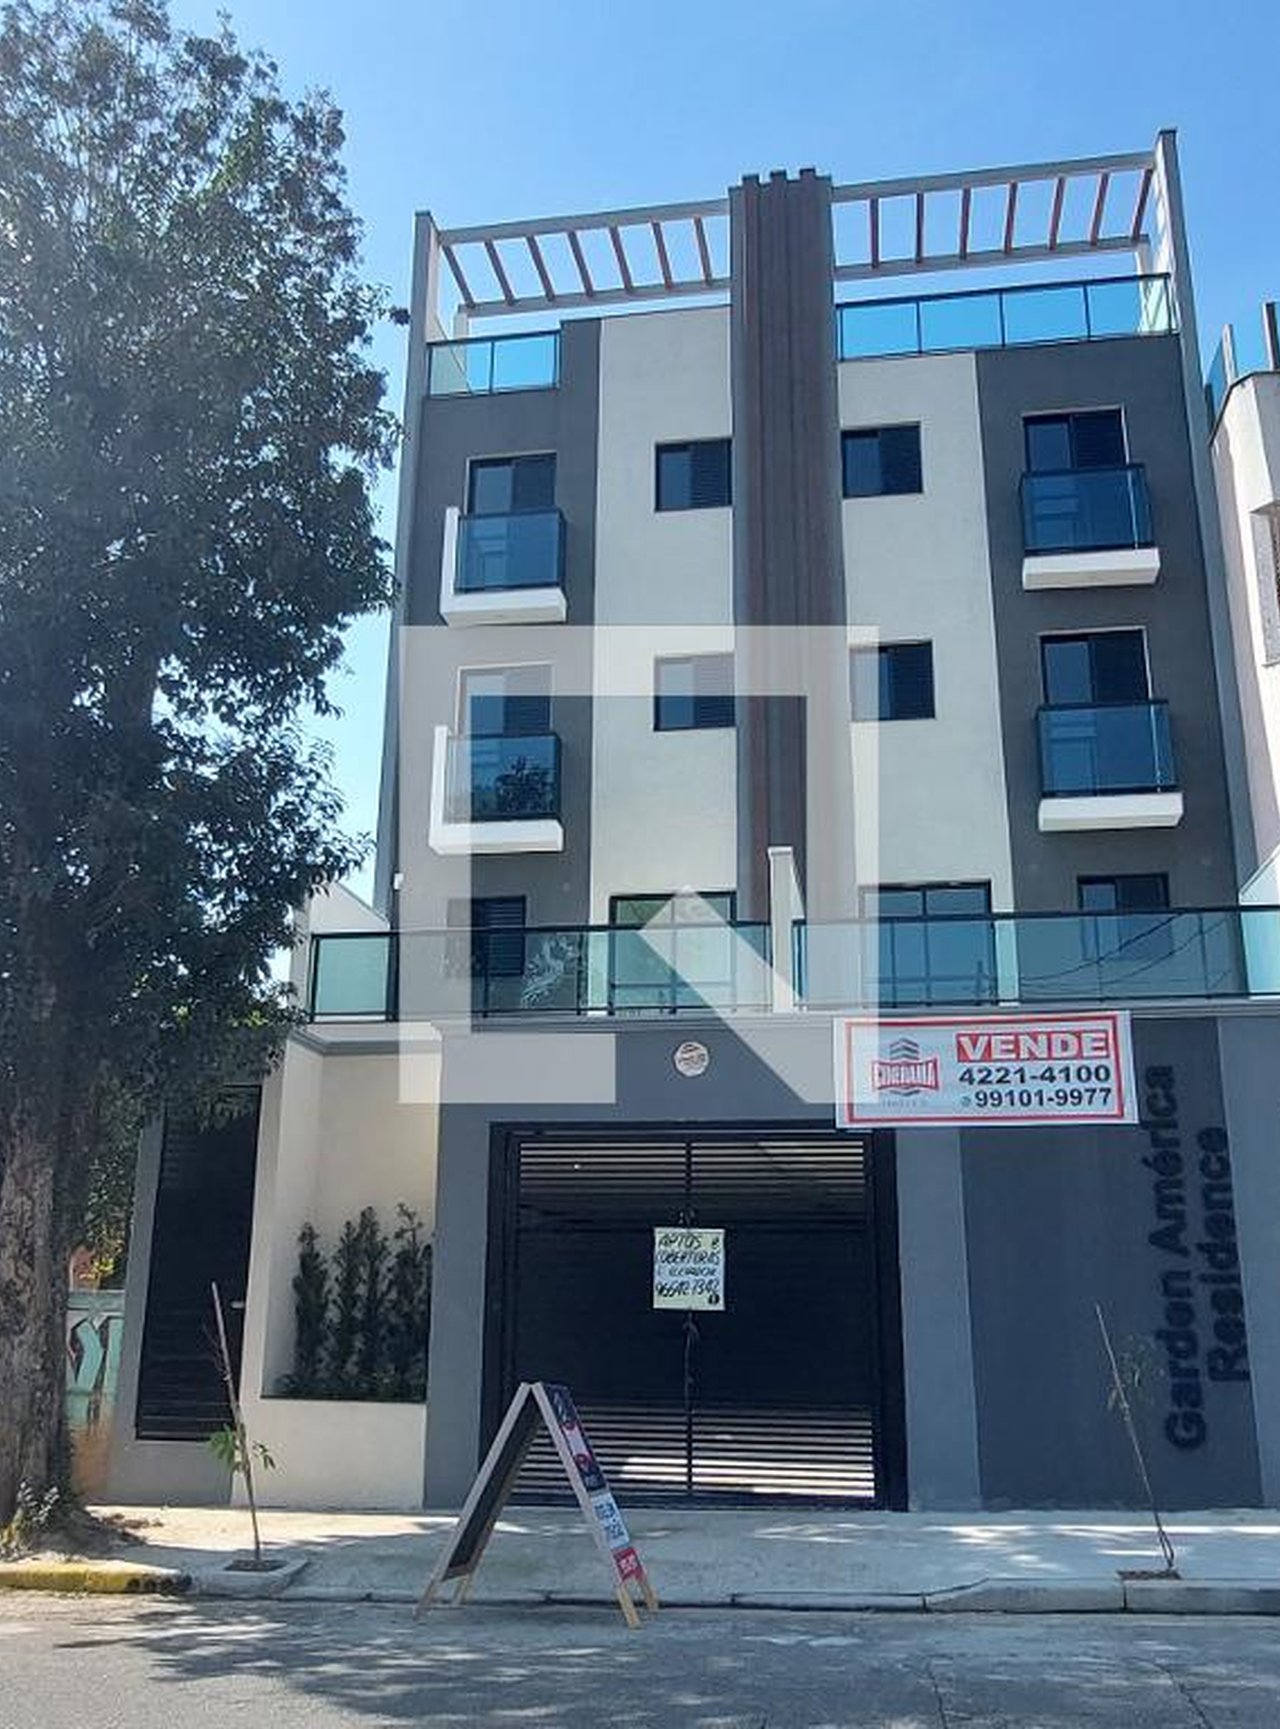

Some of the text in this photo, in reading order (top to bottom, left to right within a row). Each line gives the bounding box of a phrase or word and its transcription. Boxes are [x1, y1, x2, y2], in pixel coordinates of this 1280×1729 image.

[959, 1033, 1109, 1061] VENDE
[958, 1064, 1112, 1086] 4221-4100
[976, 1087, 1112, 1108] 99101-9977
[1141, 1064, 1207, 1452] Garden América
[1195, 1125, 1251, 1384] Residence
